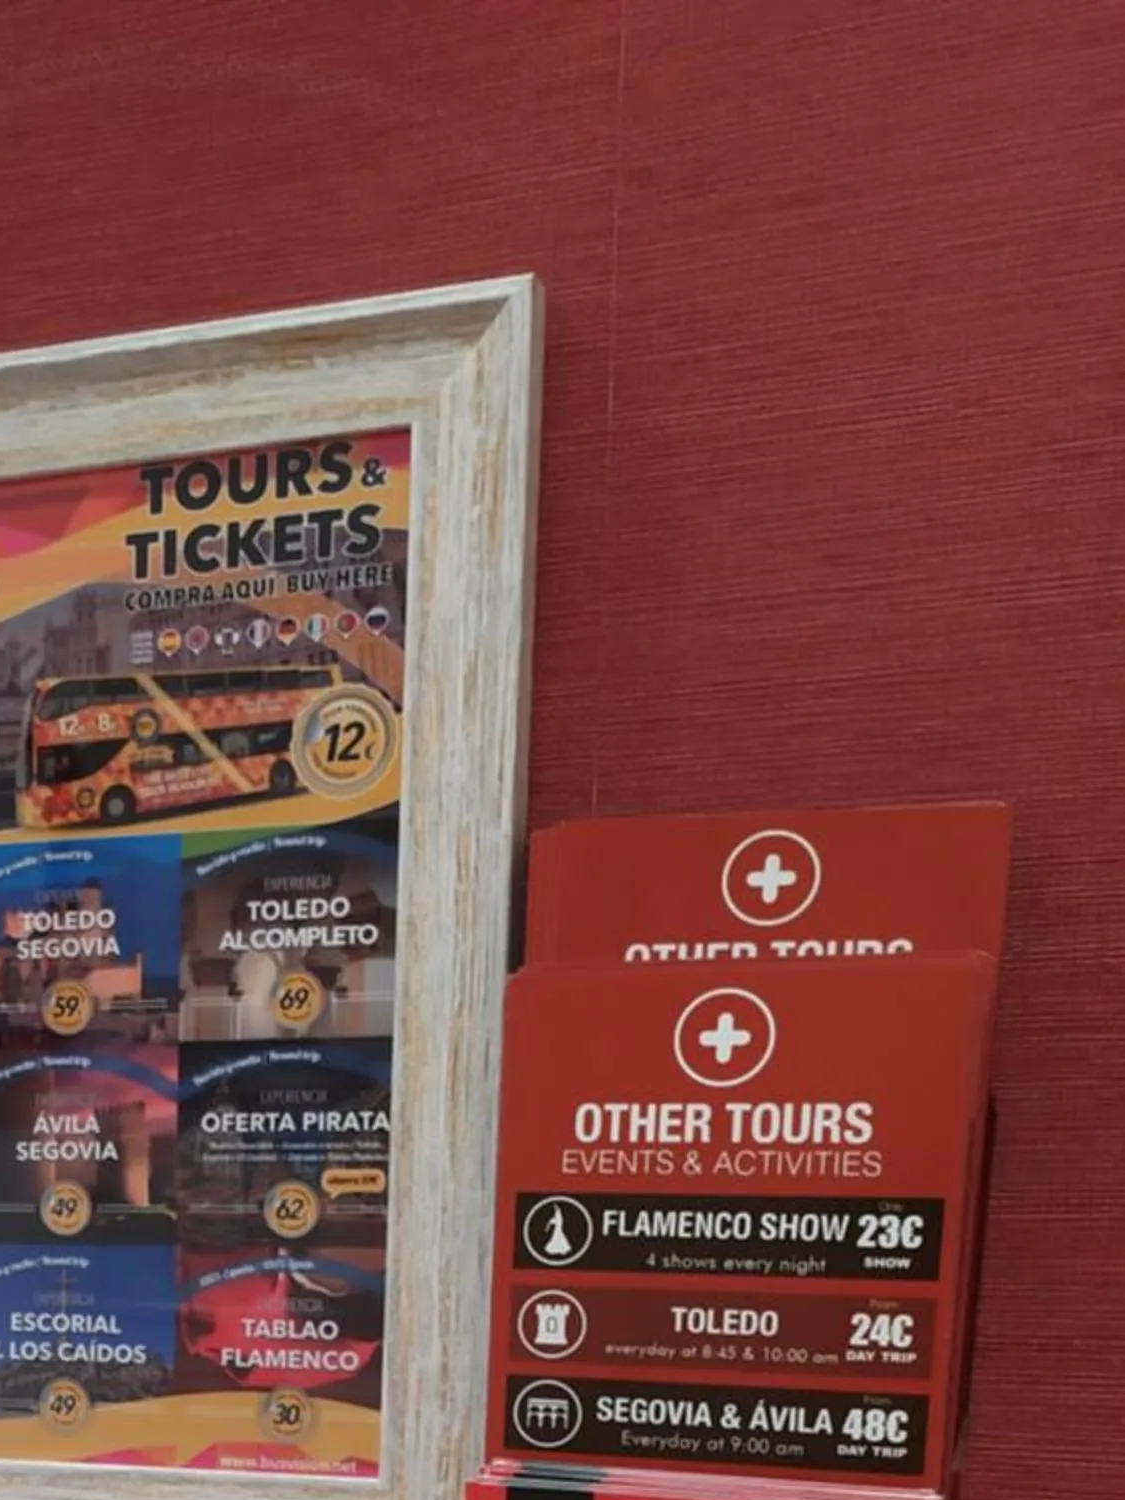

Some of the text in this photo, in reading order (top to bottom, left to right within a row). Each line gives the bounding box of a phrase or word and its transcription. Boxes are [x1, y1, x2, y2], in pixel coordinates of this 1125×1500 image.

[141, 441, 386, 514] TOURS &
[125, 504, 381, 579] TICKETS
[125, 586, 214, 612] COMPRA
[287, 572, 327, 594] BUY
[336, 564, 393, 588] HERE
[20, 908, 117, 932] TOLEDO
[246, 896, 352, 922] TOLEDO
[15, 936, 122, 960] SEGOVIA
[32, 1110, 101, 1135] ÁVILA
[200, 1111, 391, 1134] OFERTA PIRATA
[575, 1101, 874, 1144] OTHER TOURS
[15, 1140, 120, 1163] SEGOVIA
[561, 1148, 883, 1178] EVENTS & ACTIVITIES
[602, 1209, 924, 1250] FLAMENCO SHOW 23€
[645, 1253, 827, 1277] 4 shows every night
[10, 1311, 123, 1335] ESCORIAL
[241, 1317, 340, 1341] TABLAO
[671, 1306, 915, 1349] TOLEDO 24€
[9, 1341, 53, 1361] LOS
[220, 1347, 360, 1372] FLAMENCO
[604, 1342, 676, 1361] everyday
[763, 1348, 809, 1364] 10:00
[812, 1353, 839, 1365] am
[845, 1350, 918, 1364] DAY TRIP
[595, 1395, 910, 1443] SEGOVIA & ÁVILA 48€
[620, 1430, 805, 1457] Everyday at 9:00 am
[836, 1444, 909, 1459] DAY TRIP
